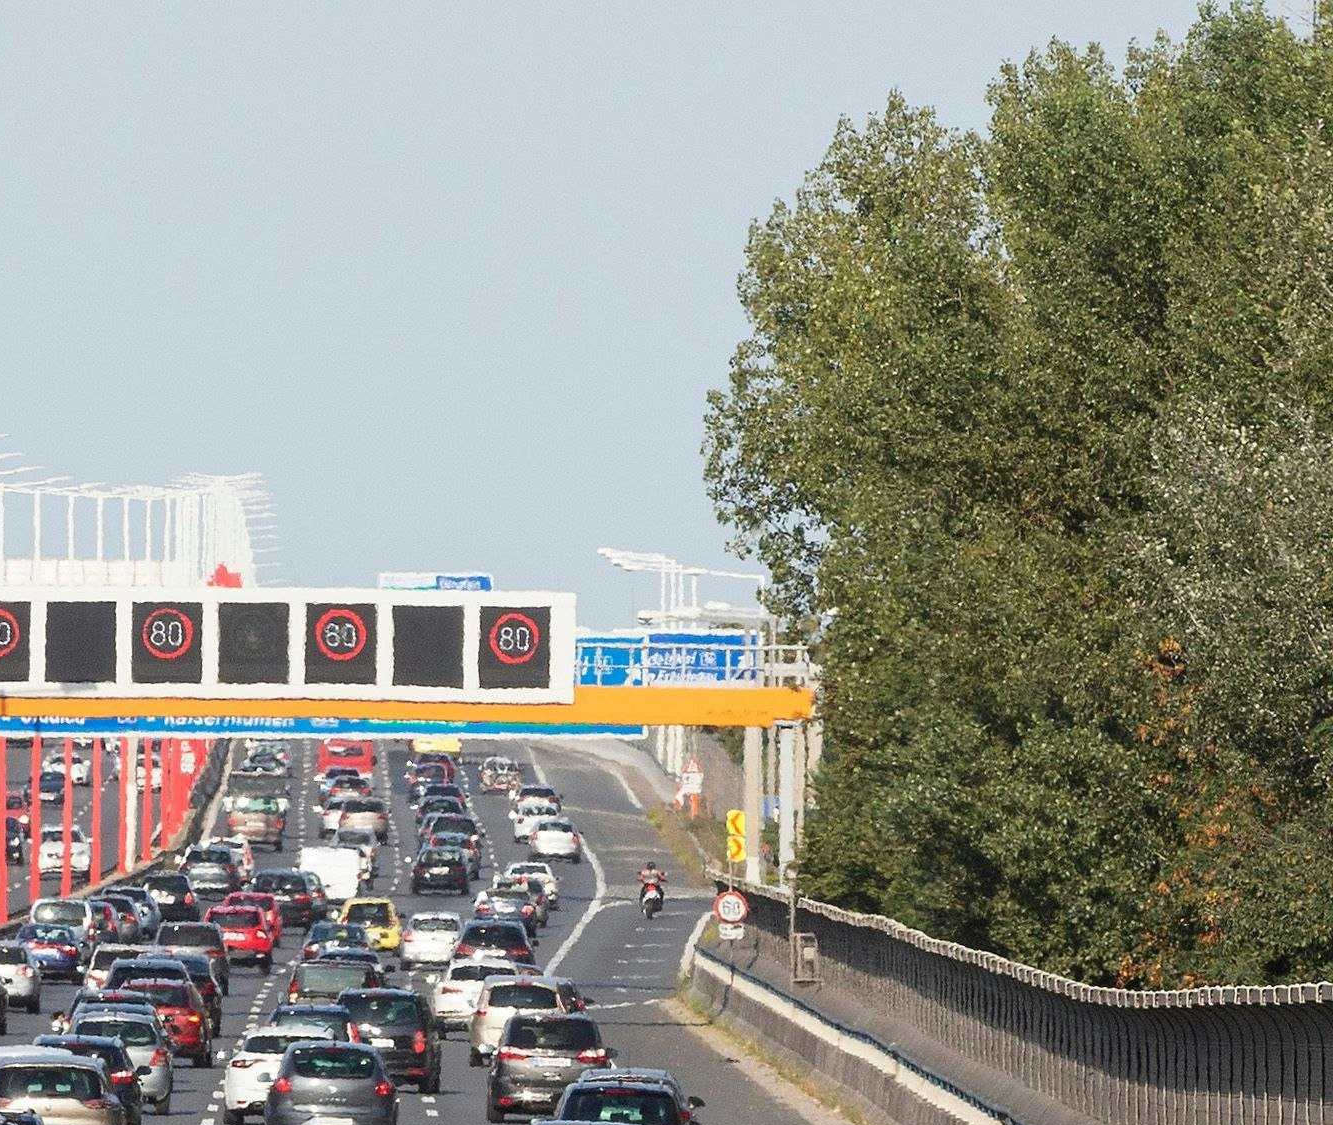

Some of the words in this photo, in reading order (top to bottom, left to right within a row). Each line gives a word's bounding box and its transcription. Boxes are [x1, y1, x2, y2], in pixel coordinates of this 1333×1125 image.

[150, 621, 183, 646] 80
[324, 622, 357, 647] 80
[499, 626, 530, 651] 80
